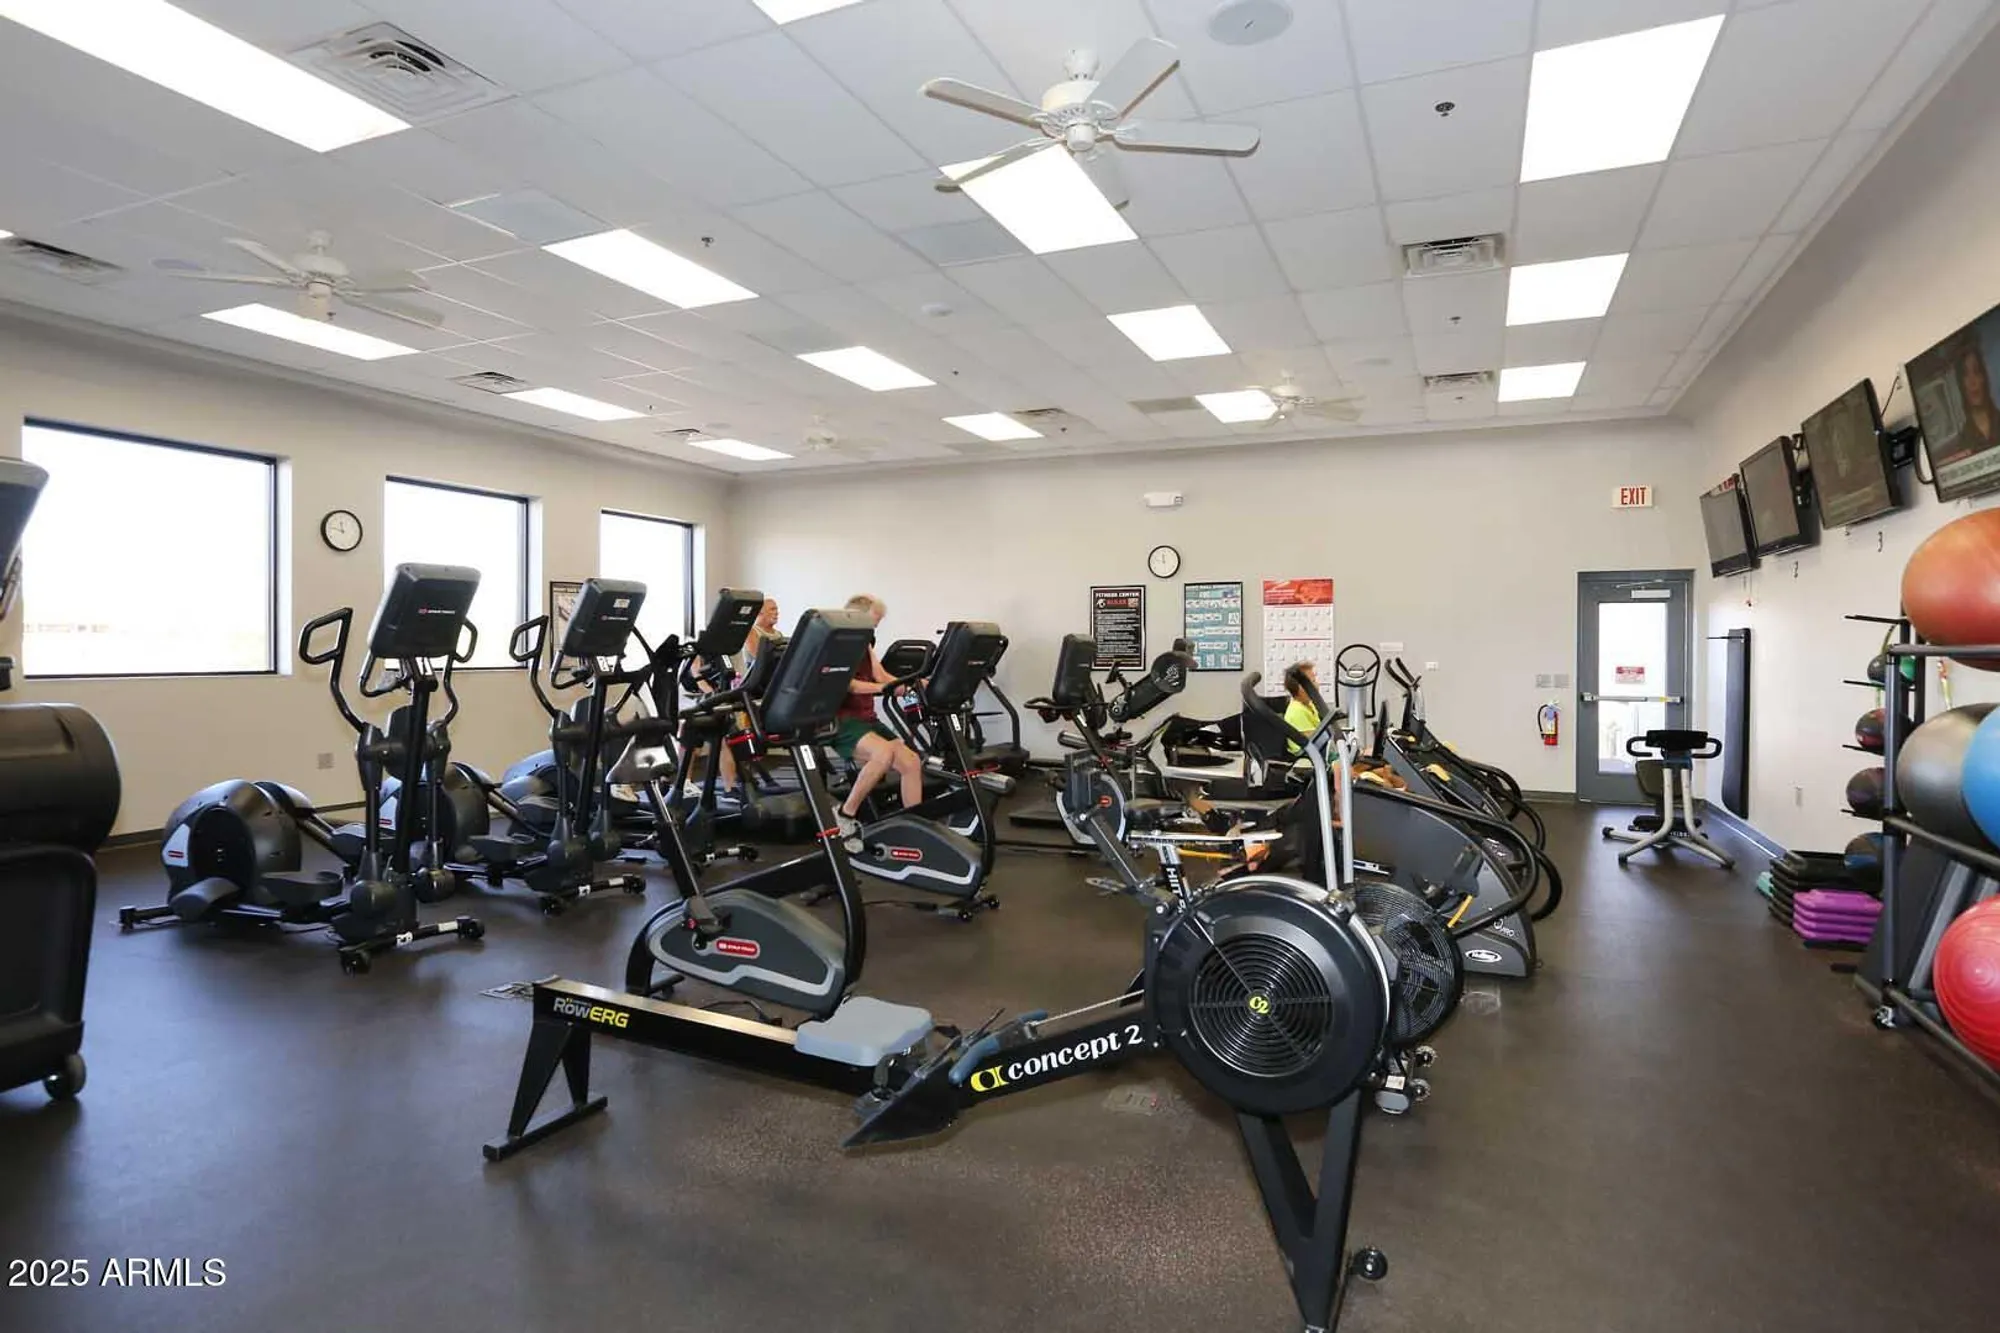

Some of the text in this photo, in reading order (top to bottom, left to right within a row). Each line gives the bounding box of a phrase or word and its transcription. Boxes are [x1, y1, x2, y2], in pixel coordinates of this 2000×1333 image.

[1621, 487, 1647, 505] EXIT
[1007, 1024, 1144, 1081] concept 2
